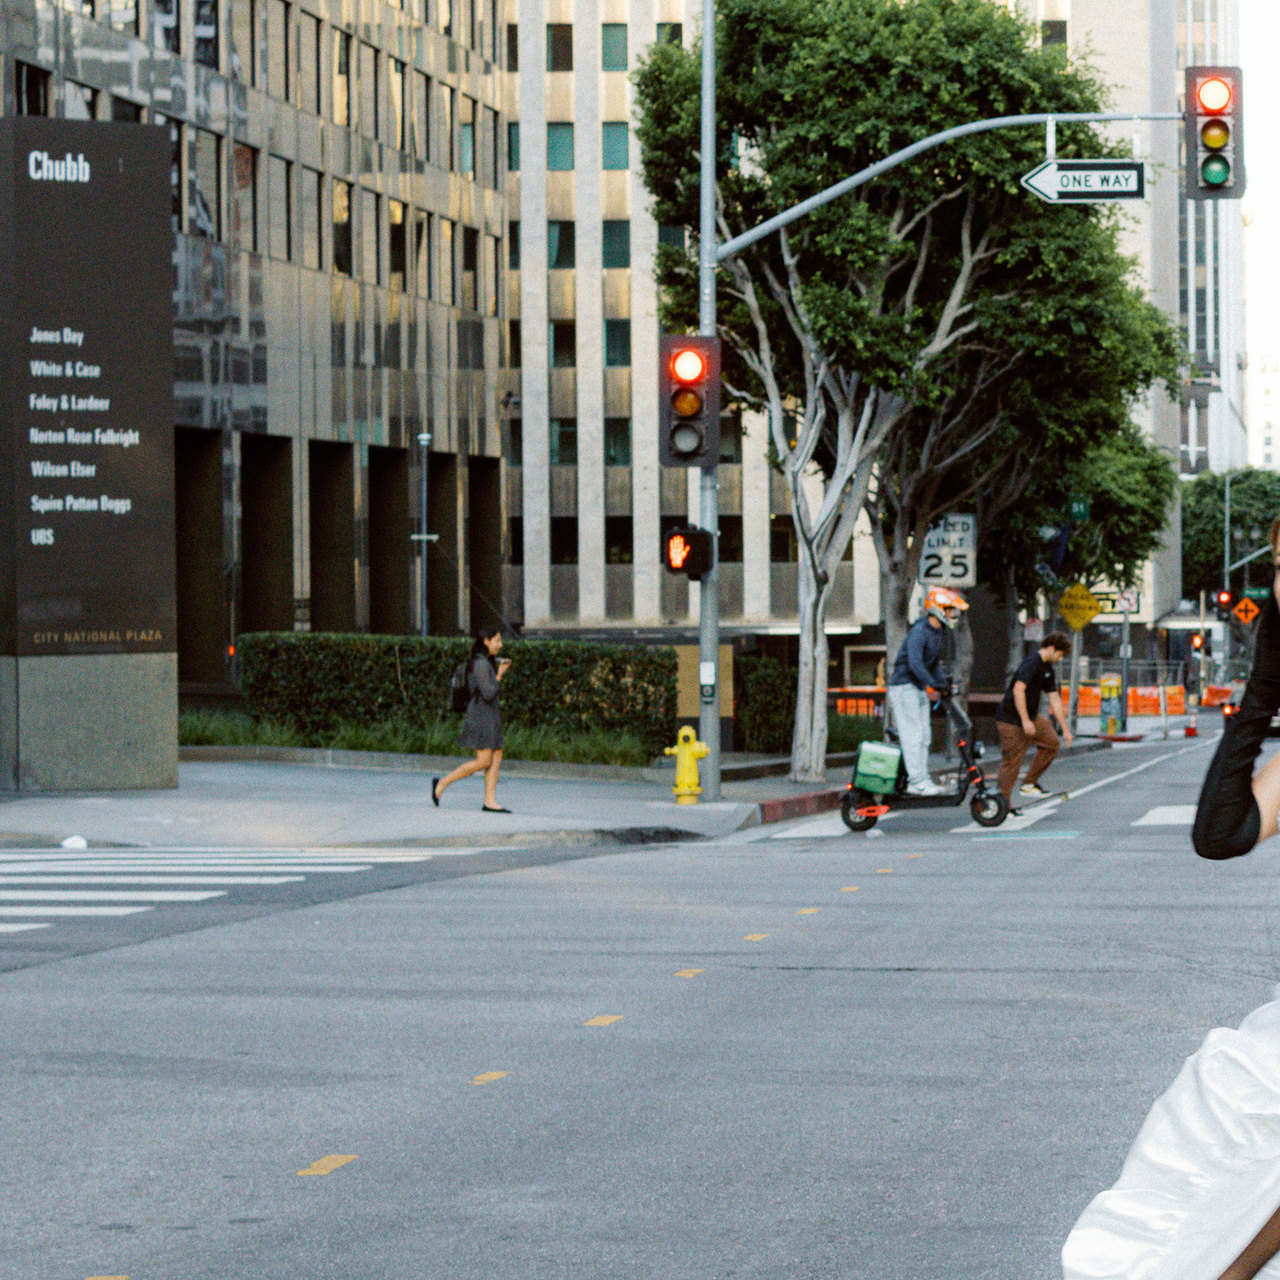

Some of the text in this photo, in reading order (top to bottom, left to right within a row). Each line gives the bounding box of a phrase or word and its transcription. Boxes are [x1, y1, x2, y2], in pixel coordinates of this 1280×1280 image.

[28, 150, 91, 183] Chubb
[1060, 173, 1132, 188] ONE WAY
[30, 327, 84, 346] Jones Day
[30, 360, 101, 377] White & Case
[29, 393, 58, 412] Foley
[60, 394, 69, 410] &
[29, 427, 65, 444] Norton
[66, 428, 93, 444] Rose
[31, 461, 69, 477] Wilson
[31, 495, 64, 514] Squire
[65, 495, 99, 511] Patton
[31, 528, 54, 545] UBS
[924, 553, 969, 579] 25
[34, 629, 162, 644] CITY NATIONAL PLAZA
